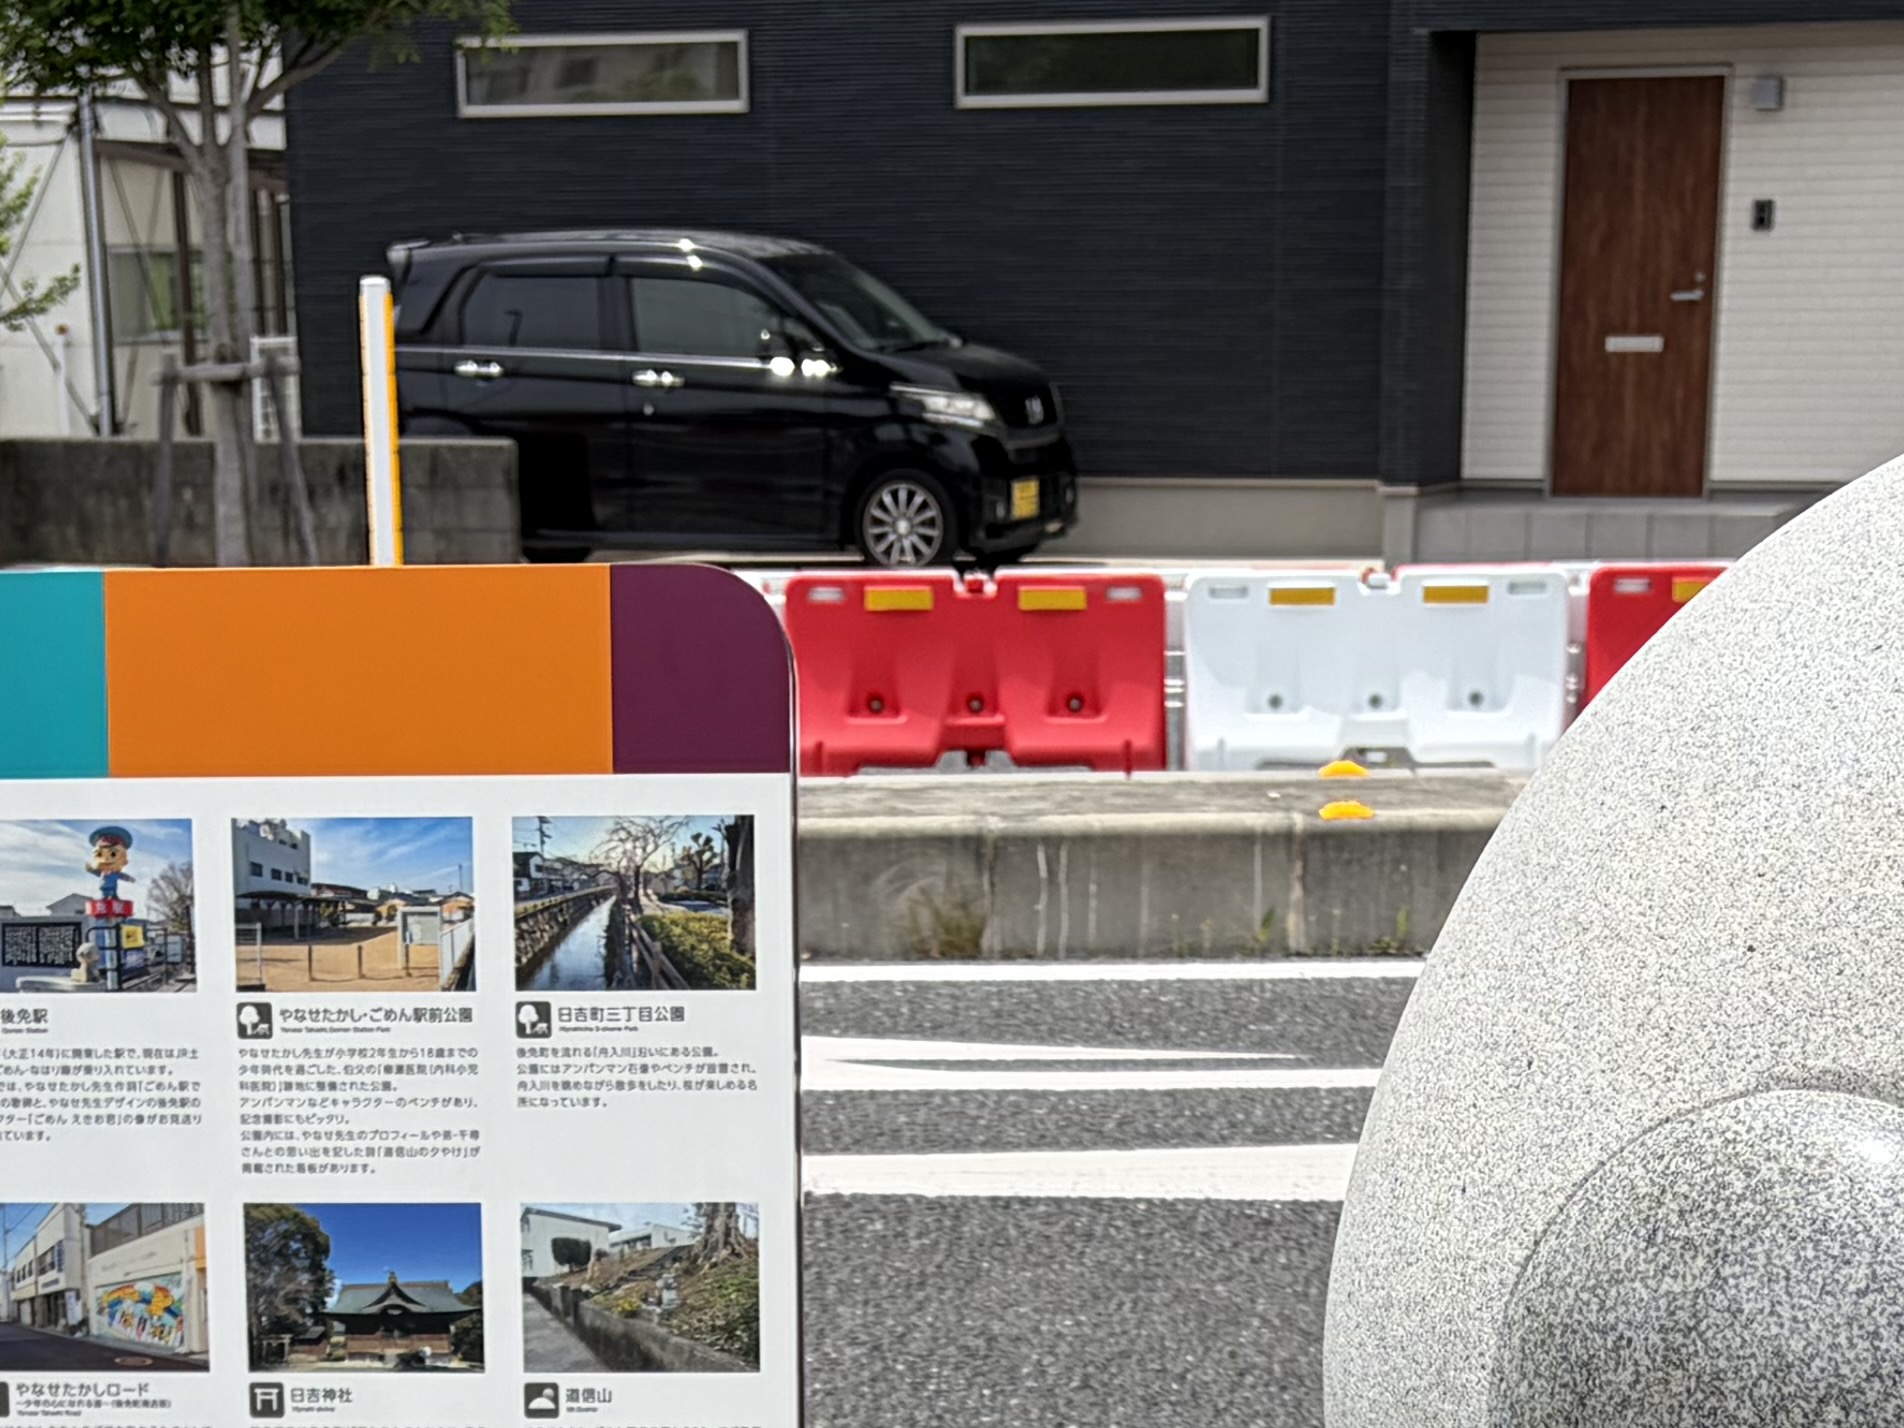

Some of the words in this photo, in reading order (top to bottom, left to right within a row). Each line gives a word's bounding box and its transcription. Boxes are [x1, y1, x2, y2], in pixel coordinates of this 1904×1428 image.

[1, 1008, 48, 1024] 後免駅
[280, 1007, 473, 1023] やなせたかし・ごめん駅前公園
[558, 1006, 685, 1022] 日吉町三丁目公園
[16, 1383, 149, 1397] やなせたかしロード
[290, 1388, 352, 1403] 日吉神社
[565, 1388, 612, 1403] 道信山
